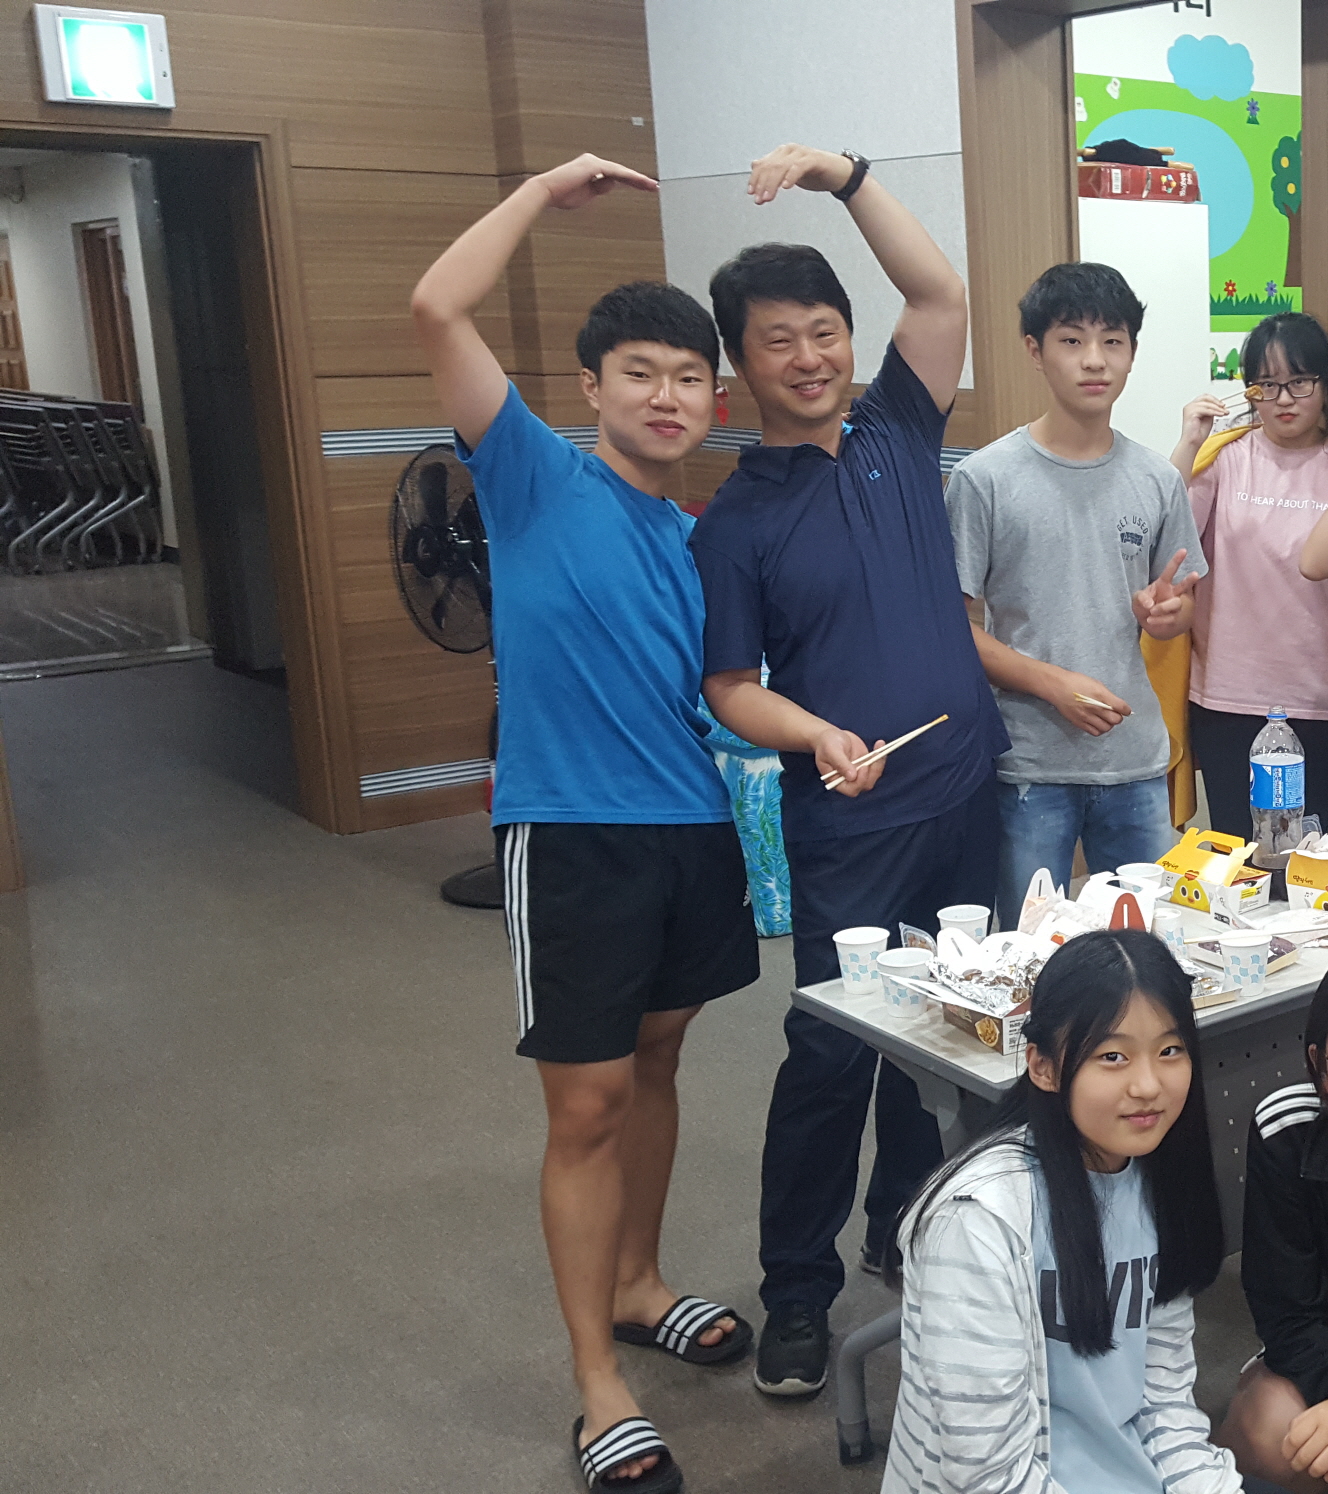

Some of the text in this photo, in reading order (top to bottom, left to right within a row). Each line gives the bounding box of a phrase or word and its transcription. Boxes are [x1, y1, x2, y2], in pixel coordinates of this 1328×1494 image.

[1237, 492, 1248, 501] TO
[1250, 496, 1274, 506] HEAR
[1277, 499, 1309, 509] ABOUT
[1132, 515, 1149, 534] USED
